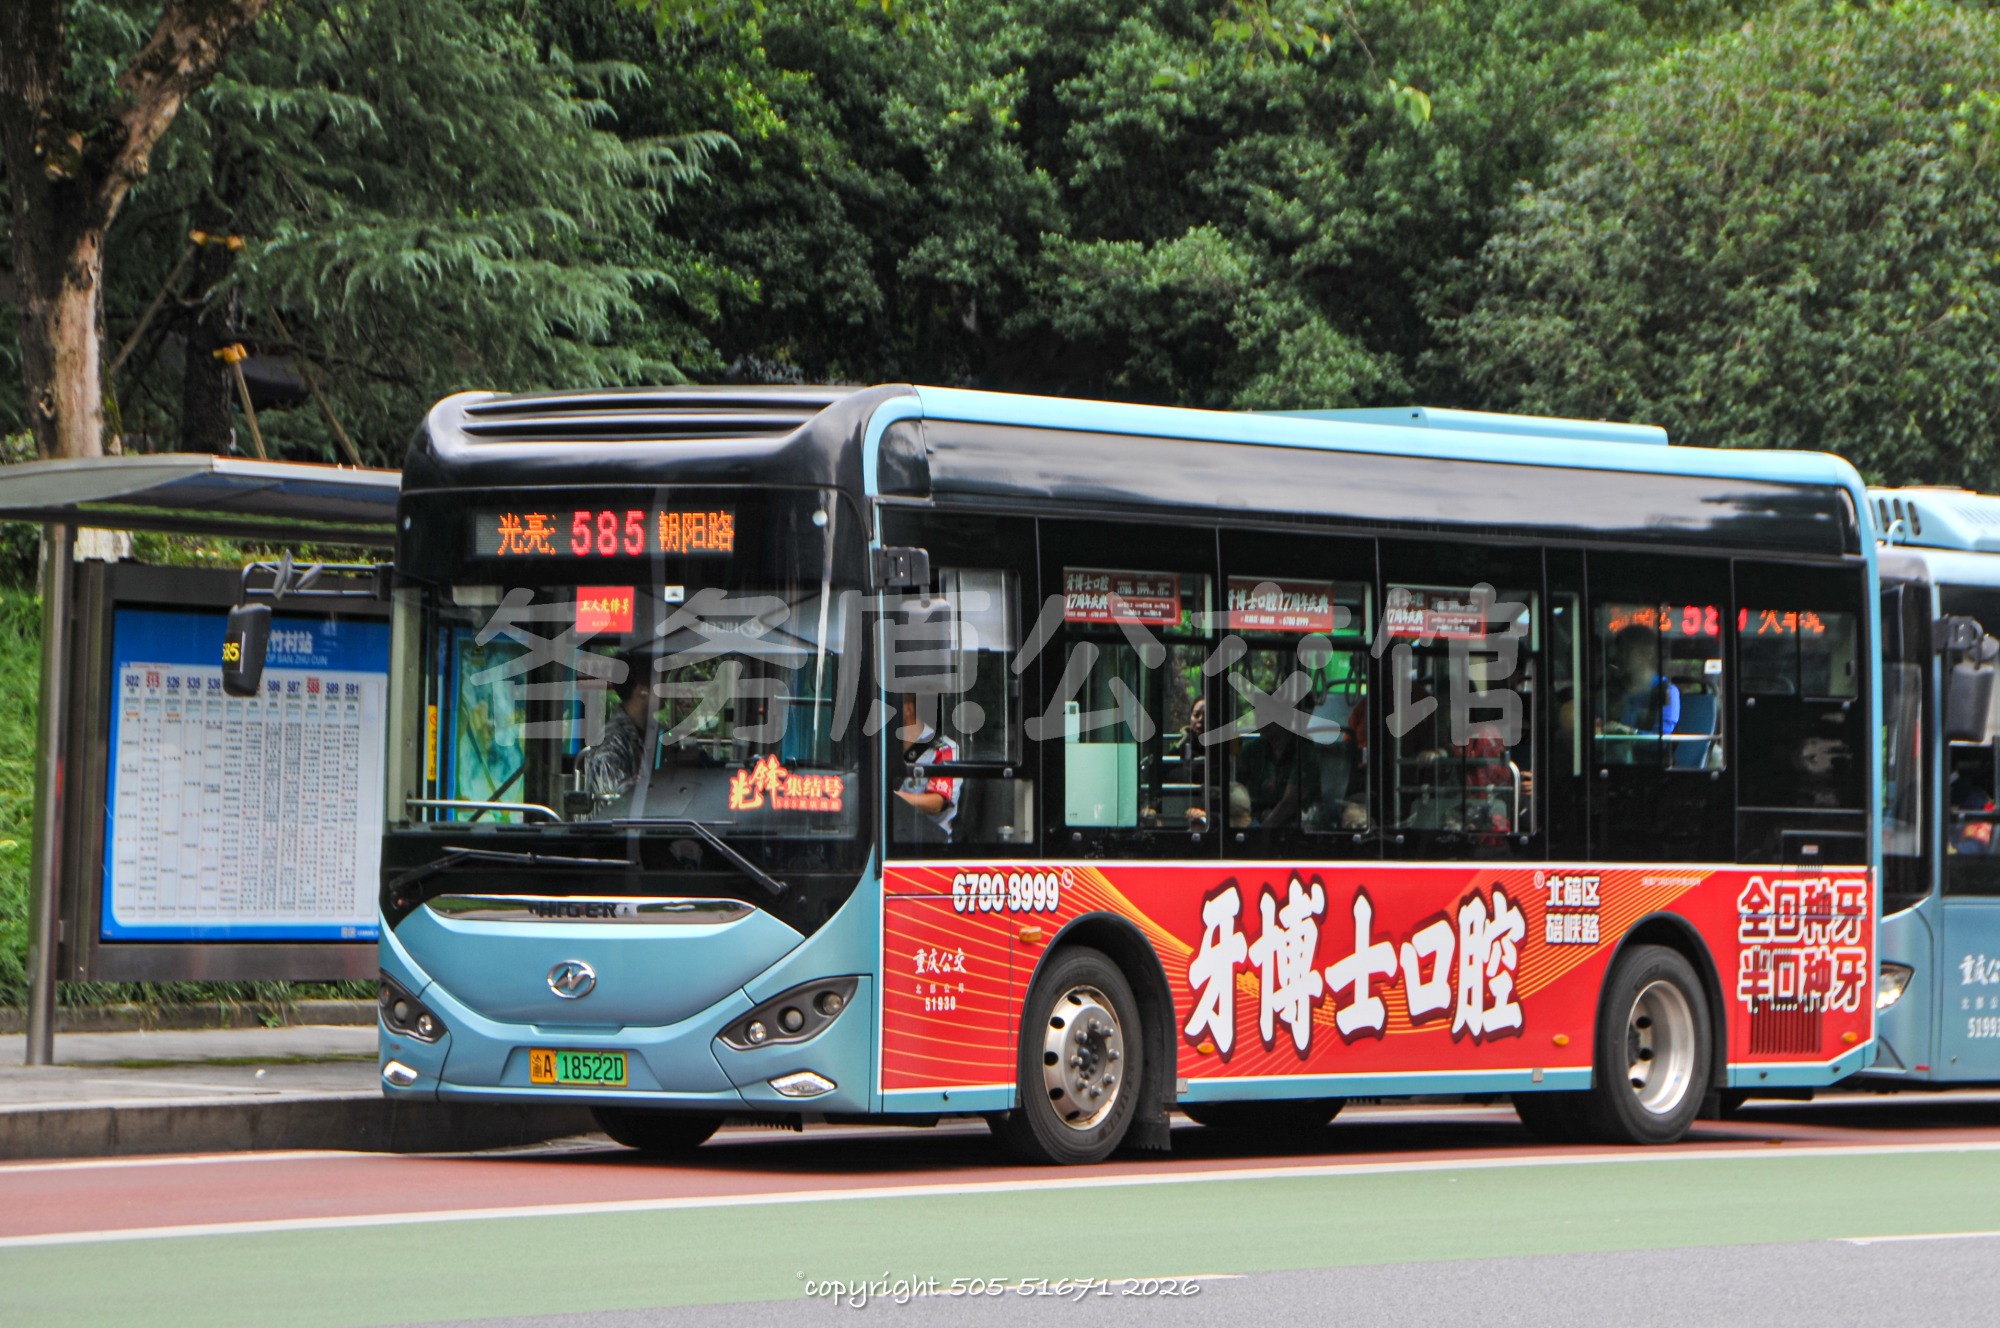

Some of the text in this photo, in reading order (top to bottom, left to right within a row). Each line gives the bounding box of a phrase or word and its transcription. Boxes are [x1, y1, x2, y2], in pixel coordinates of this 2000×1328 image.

[497, 512, 556, 556] 光亮
[571, 510, 645, 556] 585
[658, 510, 735, 554] 朝阳路
[267, 629, 313, 654] 竹村站
[125, 674, 139, 687] 502
[287, 681, 300, 693] 587
[345, 683, 359, 695] 591
[953, 872, 1060, 913] 6780 8999
[1546, 875, 1600, 907] 北碚区
[1737, 876, 1867, 945] 全口种牙
[1546, 913, 1600, 944] 碚峡路
[913, 947, 967, 974] 重庆公交
[1184, 874, 1527, 1057] 牙博士口腔
[1737, 946, 1867, 1014] 半口种牙
[925, 996, 956, 1011] 51930
